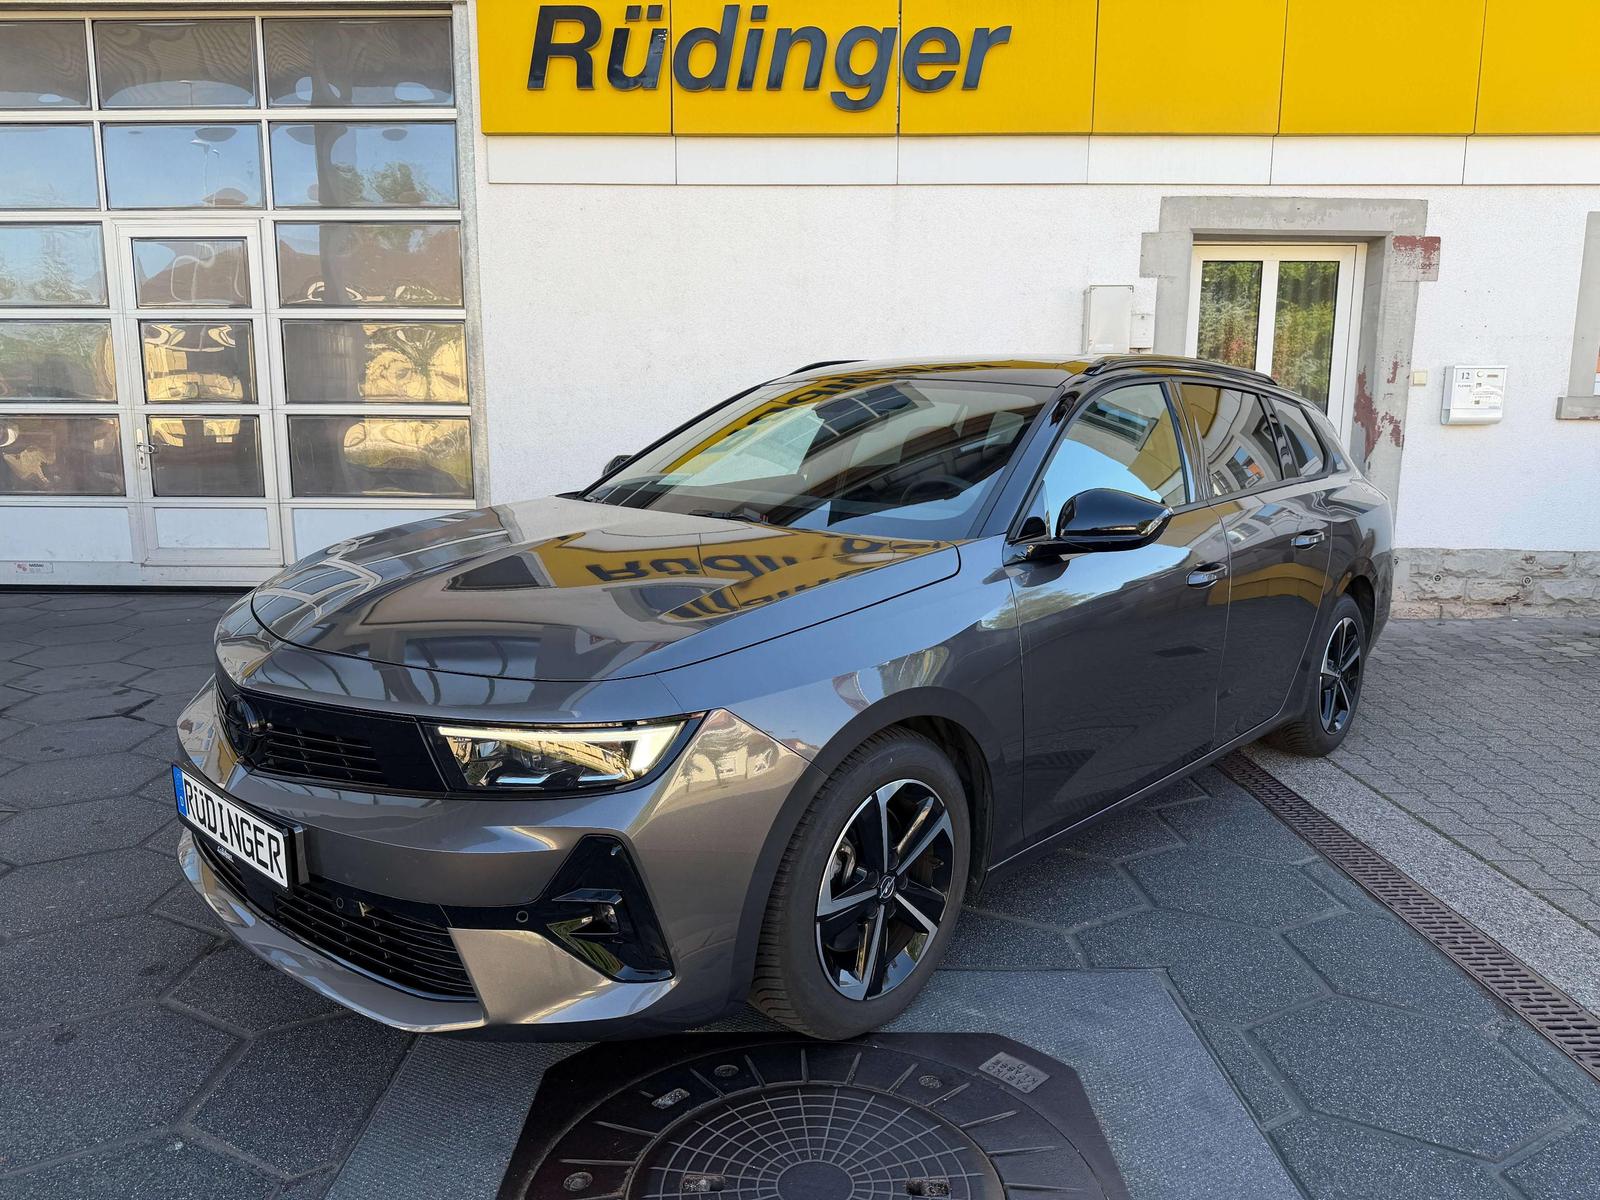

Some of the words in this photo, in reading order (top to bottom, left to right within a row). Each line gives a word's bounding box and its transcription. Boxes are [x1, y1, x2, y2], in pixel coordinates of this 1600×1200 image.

[527, 4, 1012, 112] Rüdinger
[1461, 371, 1471, 380] 12
[184, 778, 284, 880] RÜDINGER
